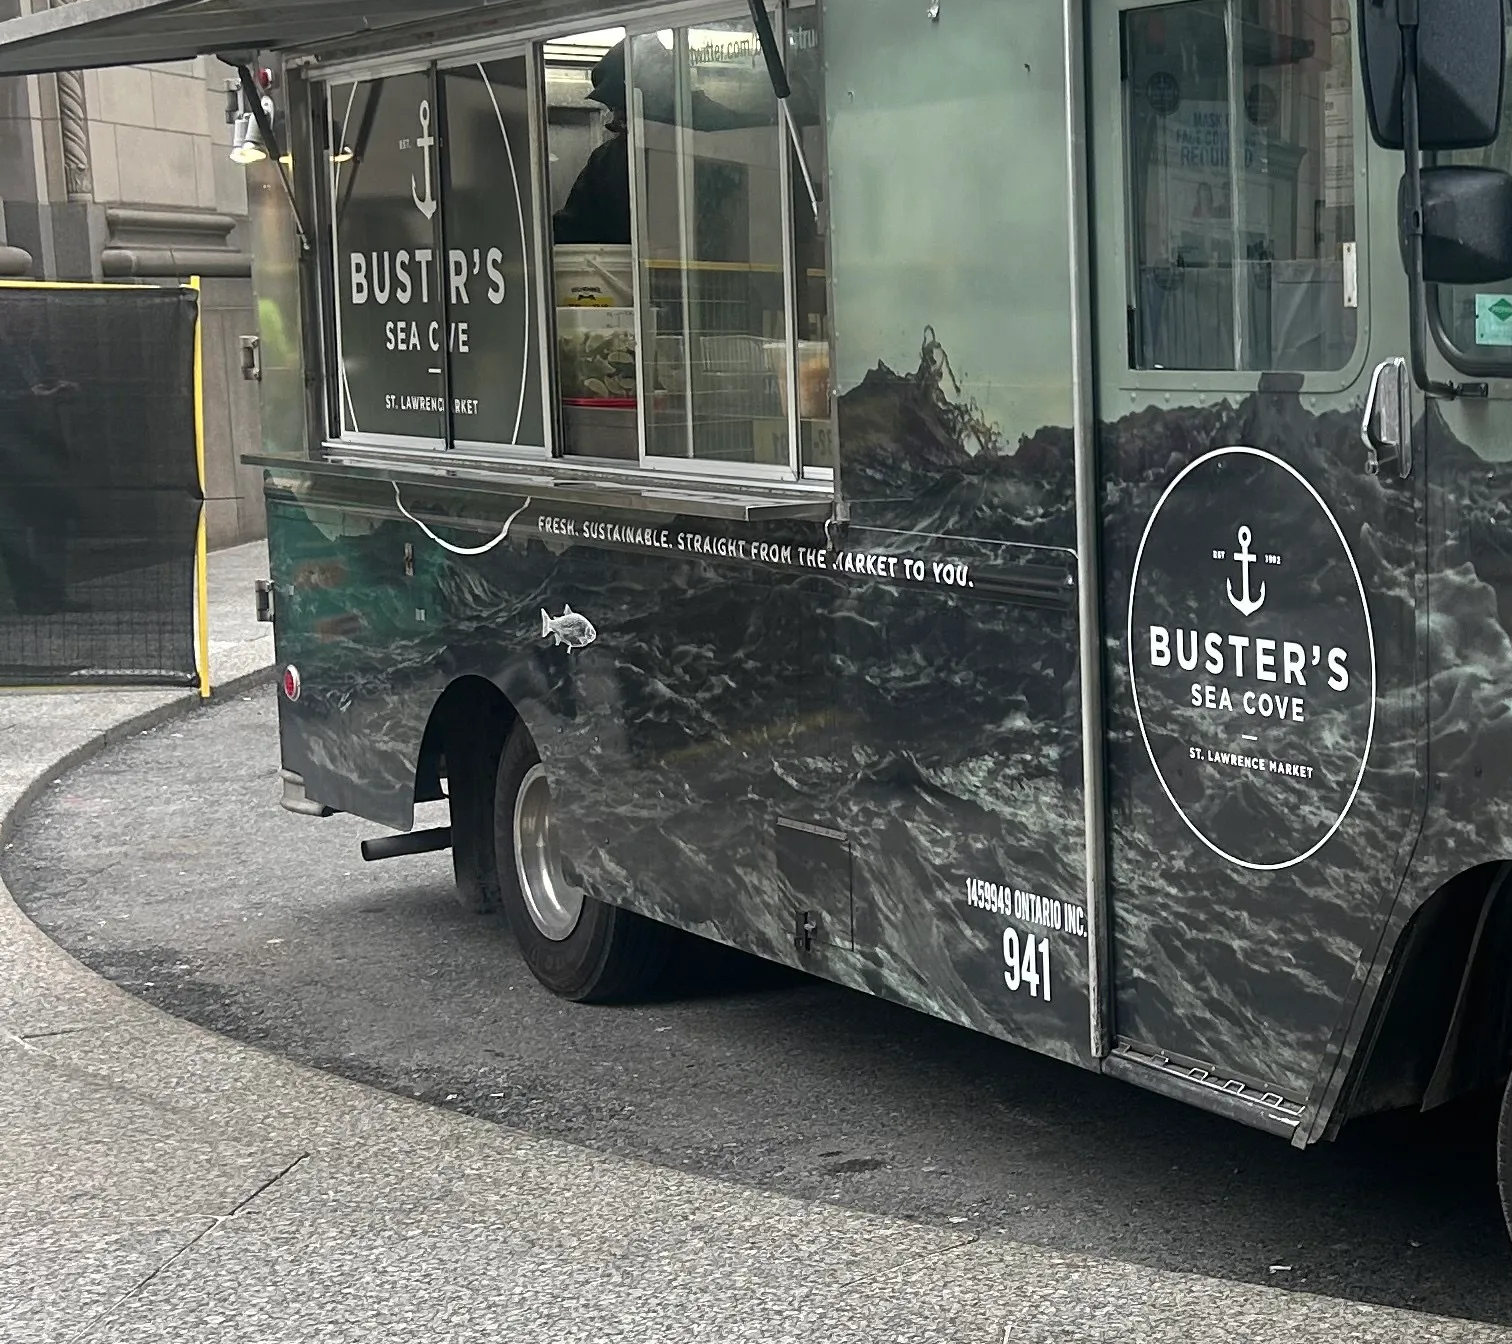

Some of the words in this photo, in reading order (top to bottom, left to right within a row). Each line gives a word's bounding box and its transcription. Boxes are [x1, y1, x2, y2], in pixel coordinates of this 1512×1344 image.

[350, 246, 505, 305] BUSTR'S
[385, 321, 421, 350] SEA
[428, 321, 469, 353] CVE
[385, 394, 399, 410] ST.
[400, 395, 445, 412] LAWRENC
[454, 398, 479, 415] RKET
[537, 515, 579, 537] FRESH.
[582, 520, 673, 549] SUSTAINABLE.
[677, 531, 746, 558] STRAIGHT
[751, 542, 792, 565] FROM
[798, 547, 827, 569] THE
[903, 558, 926, 582] TO
[931, 561, 975, 588] YOU.
[1149, 625, 1349, 692] BUSTER'S
[1190, 683, 1234, 712] SEA
[1242, 690, 1305, 723] COVE
[1189, 746, 1205, 761] ST.
[1207, 750, 1266, 772] LAWRENCE
[1269, 759, 1314, 779] MARKET
[965, 877, 1012, 916] 1459949
[1014, 889, 1062, 930] ONTARIO
[1064, 902, 1088, 938] INC.
[1002, 926, 1051, 1002] 941
